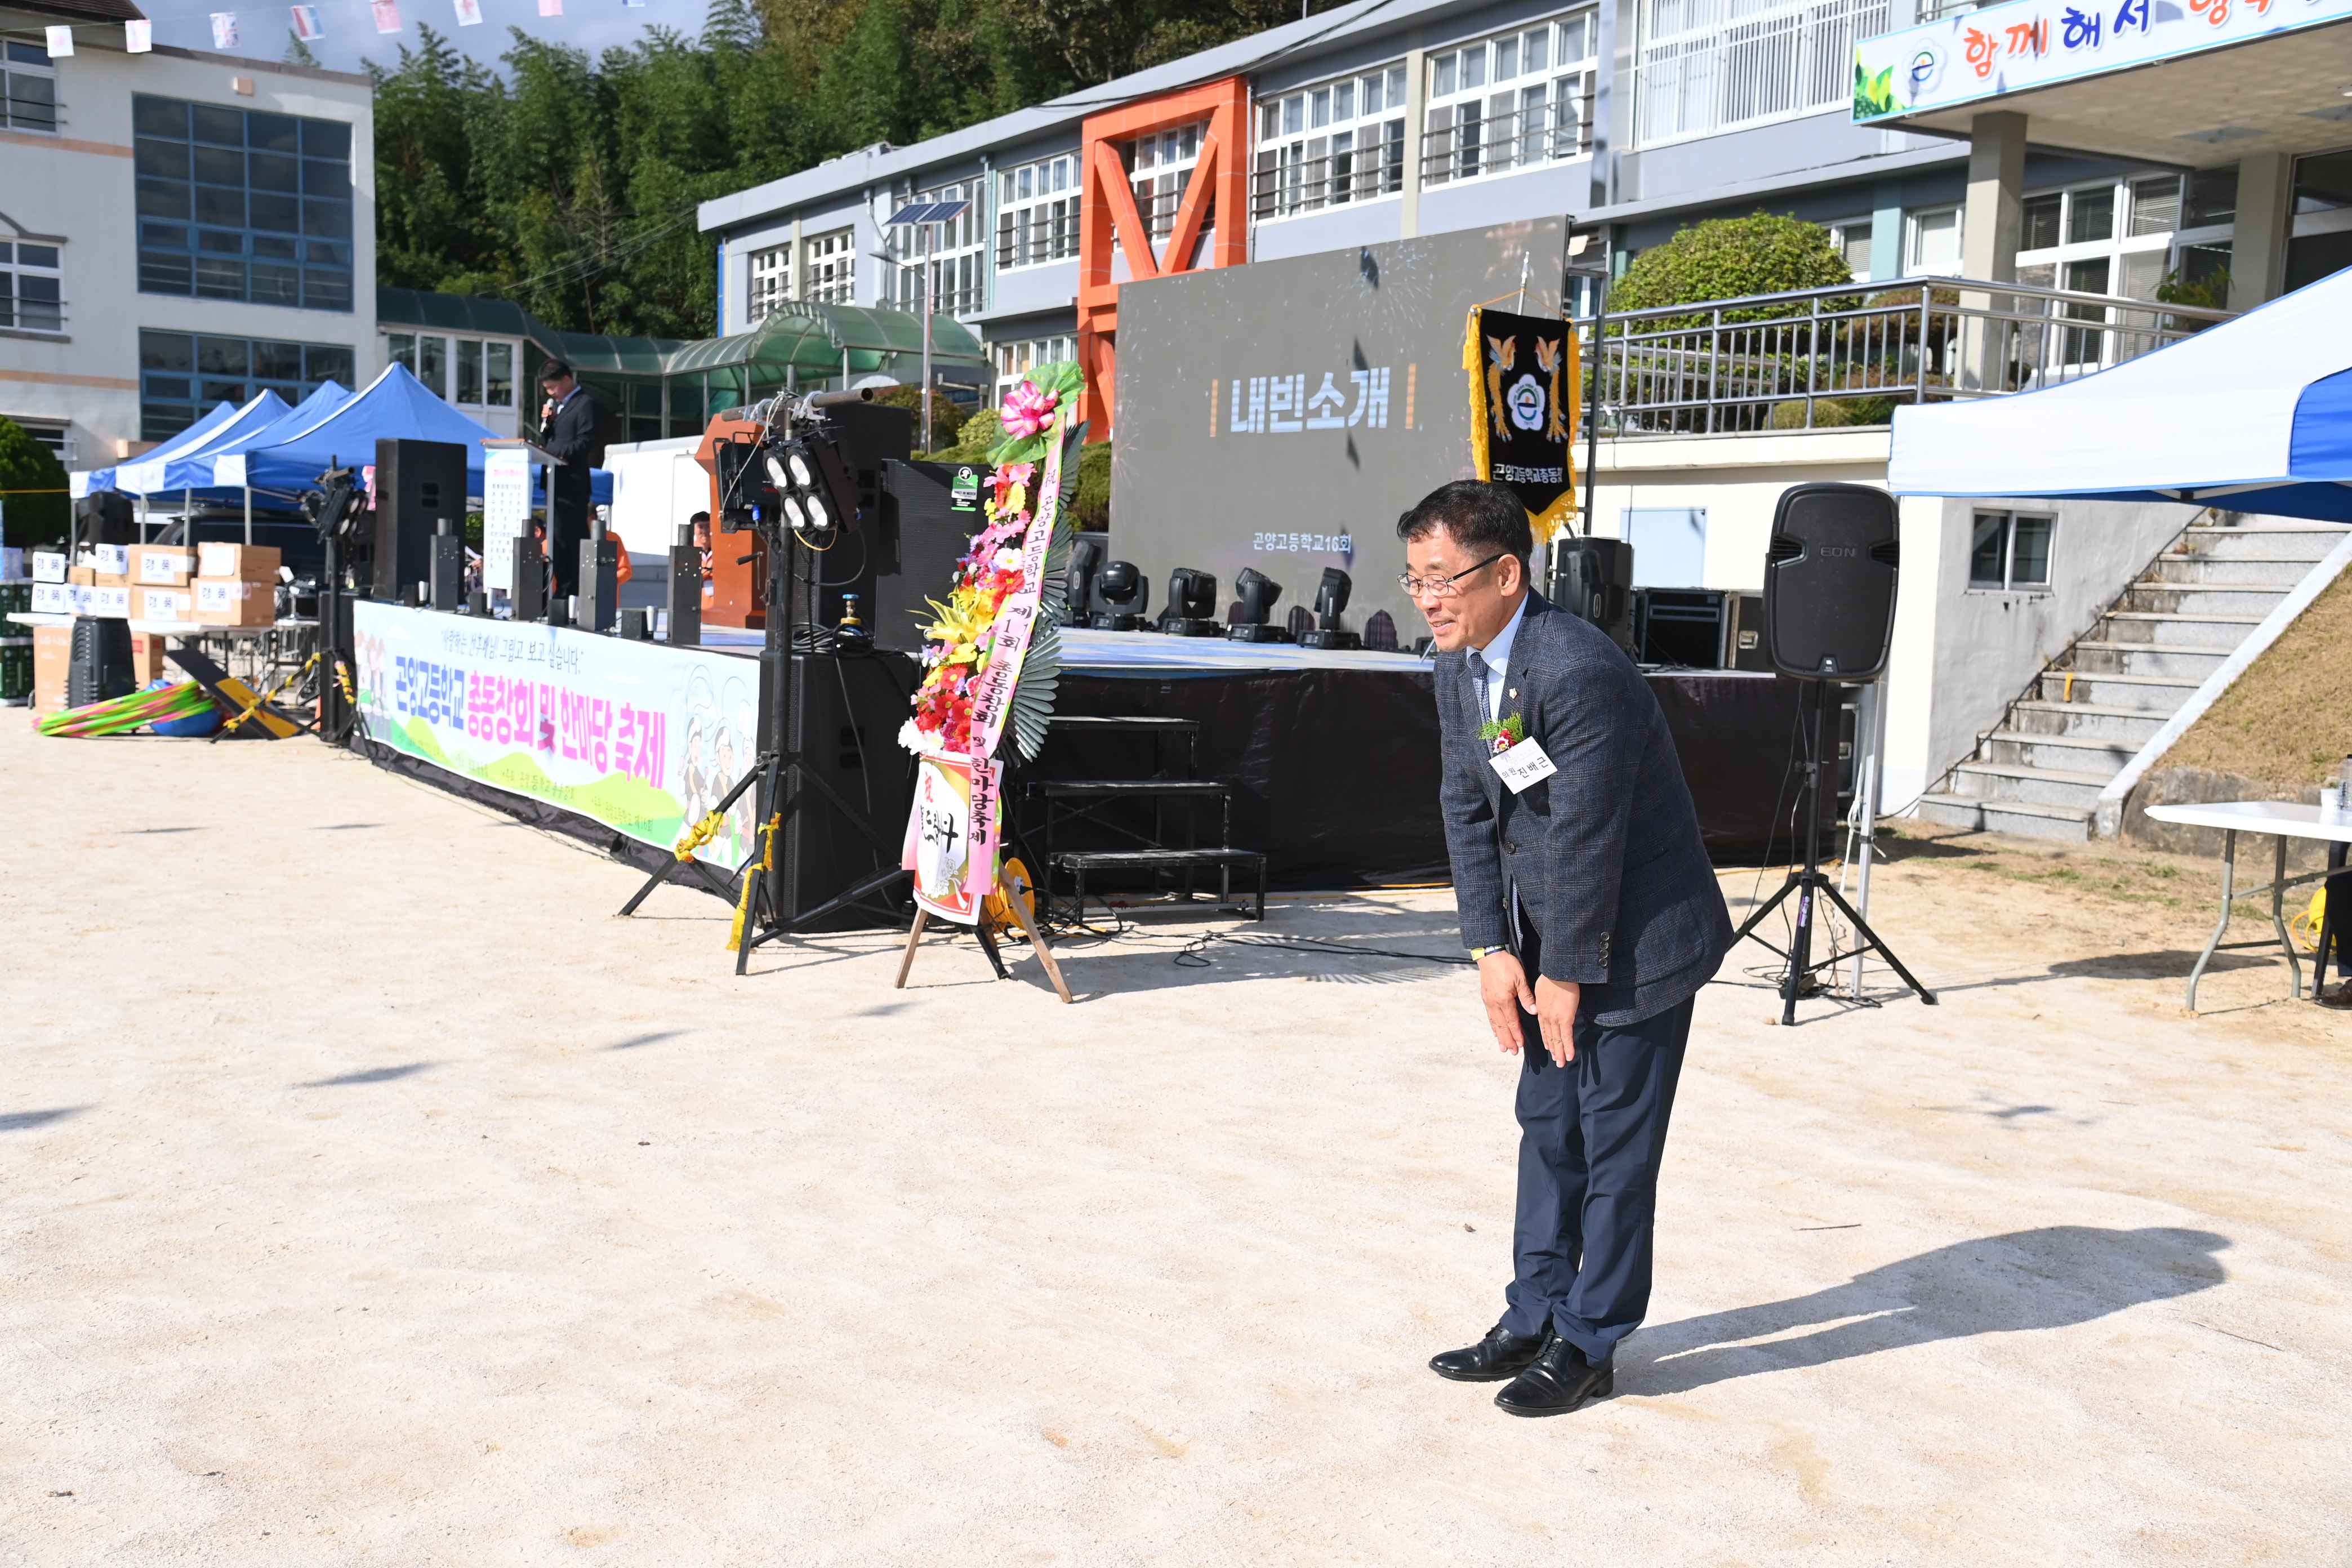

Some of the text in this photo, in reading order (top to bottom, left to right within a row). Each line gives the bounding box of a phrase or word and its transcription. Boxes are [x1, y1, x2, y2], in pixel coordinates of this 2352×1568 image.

[1231, 367, 1391, 434] 내빈소개
[1045, 469, 1057, 488] 祝
[1017, 496, 1054, 594] 곤양고등학교
[1253, 532, 1352, 554] 곤양고등학교16회
[1820, 546, 1856, 558] EON
[500, 637, 523, 662] 그립고
[527, 641, 545, 662] 보고
[972, 659, 1013, 728] 총동창회
[396, 656, 666, 790] 곤양고등학교 총동창회 및 한마당 축제
[972, 736, 986, 750] 및
[1502, 756, 1549, 778] 의원 진배근
